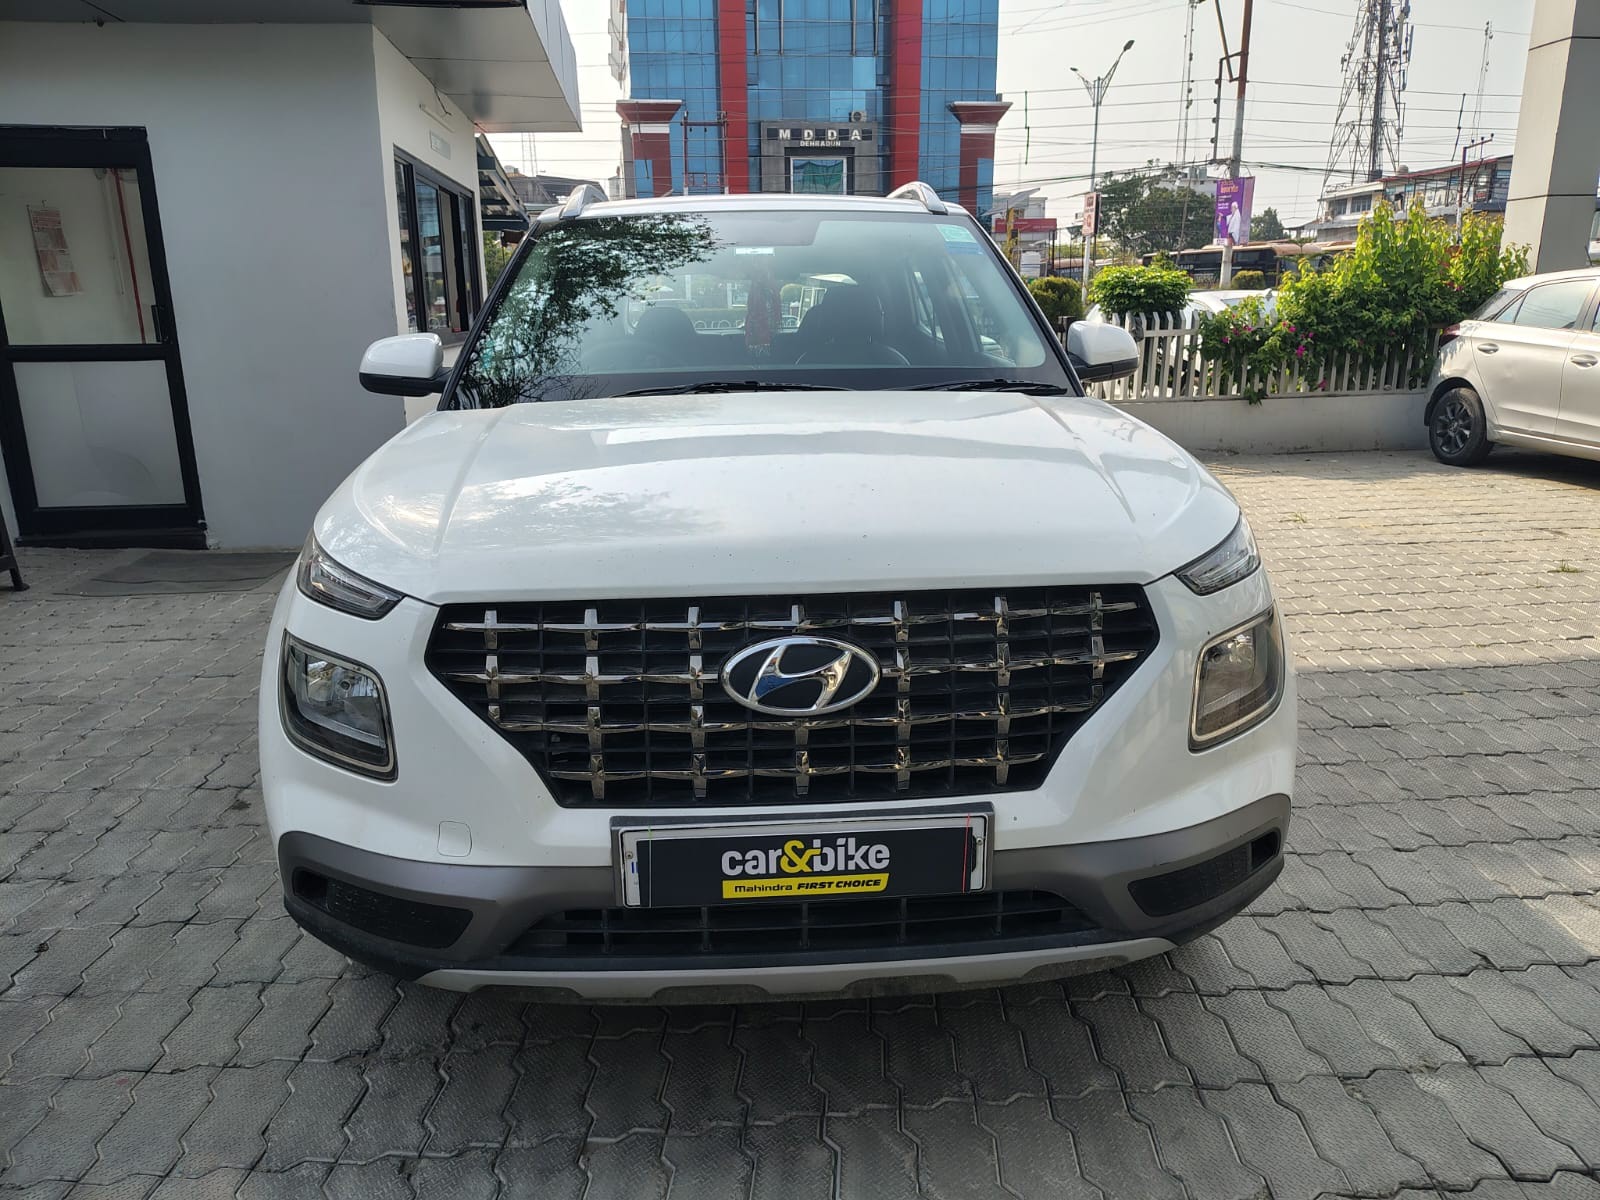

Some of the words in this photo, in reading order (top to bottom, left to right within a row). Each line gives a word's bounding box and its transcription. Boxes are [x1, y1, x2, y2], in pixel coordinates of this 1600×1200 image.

[721, 837, 890, 876] car&bike
[734, 884, 793, 893] Mahindra
[797, 881, 834, 890] FIRST
[835, 879, 881, 888] CHOICE
